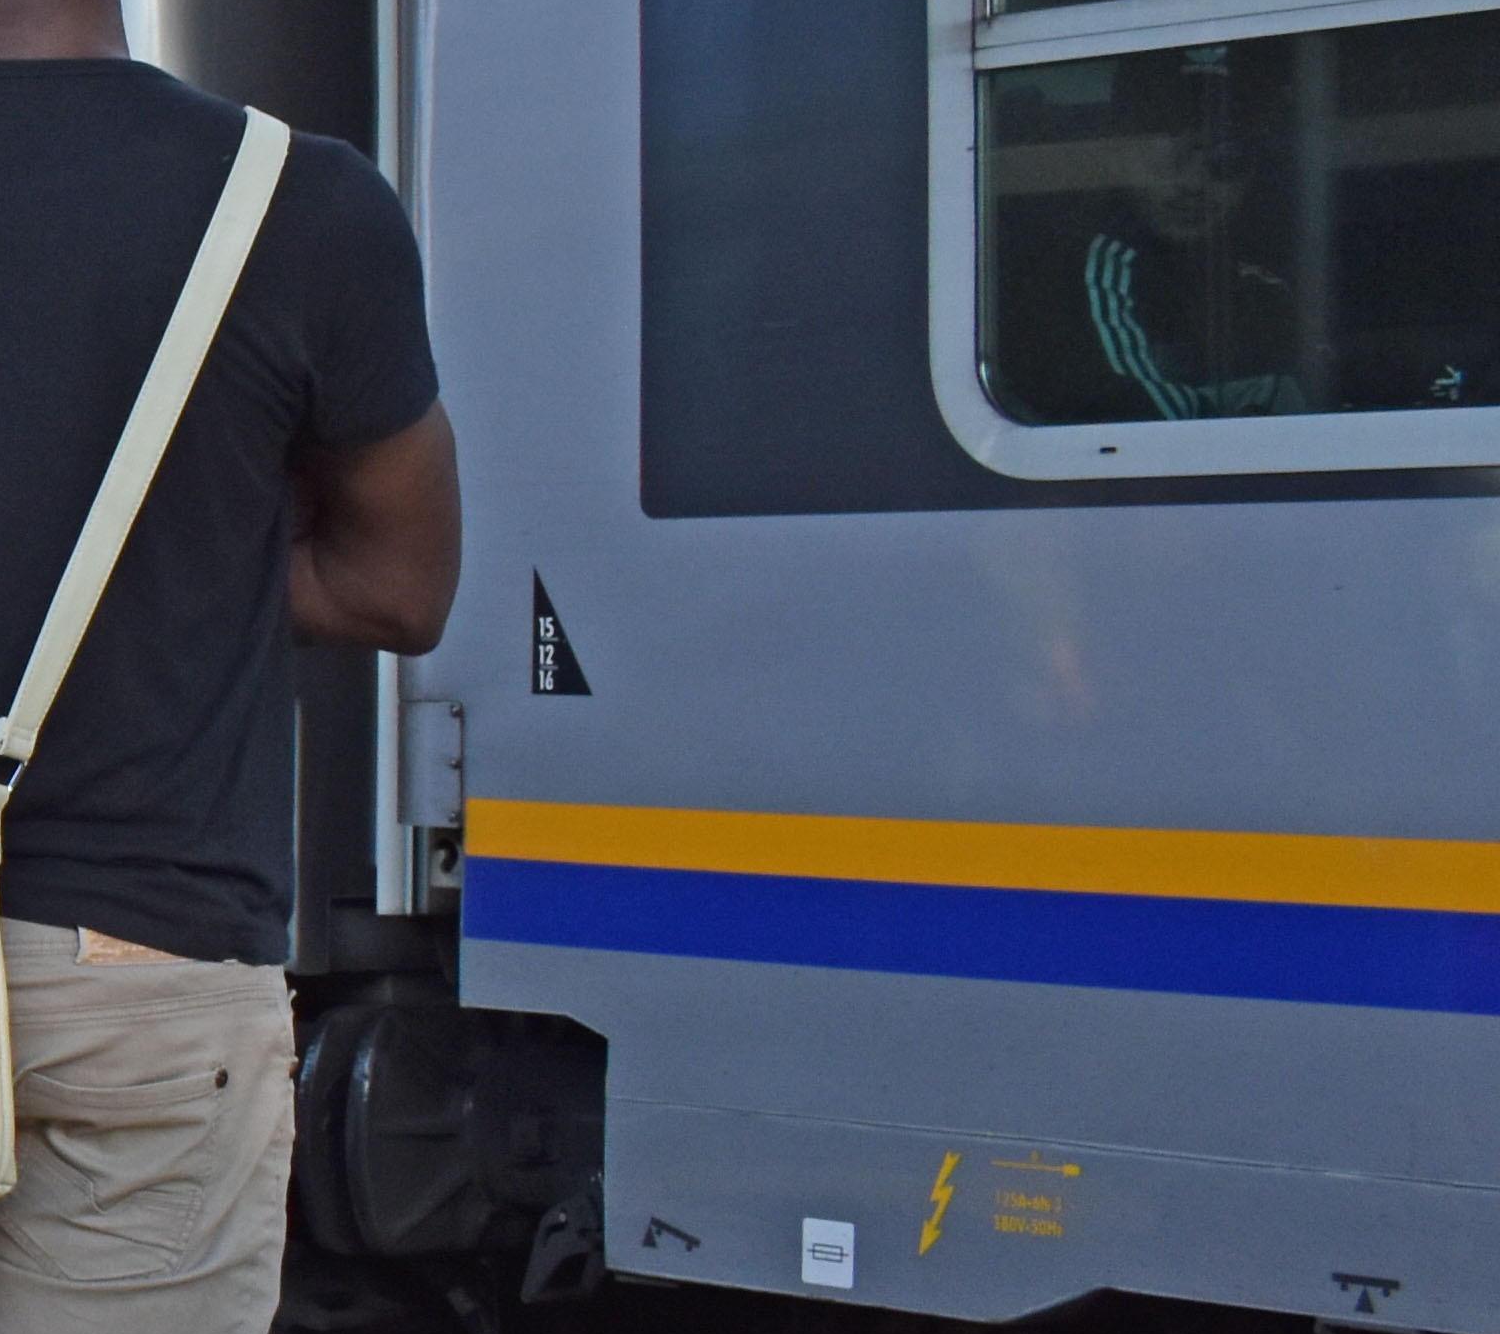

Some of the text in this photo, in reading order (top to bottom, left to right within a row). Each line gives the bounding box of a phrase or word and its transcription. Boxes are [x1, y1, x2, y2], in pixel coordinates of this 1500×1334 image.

[538, 616, 555, 638] 15
[538, 644, 555, 666] 12
[538, 670, 555, 691] 16
